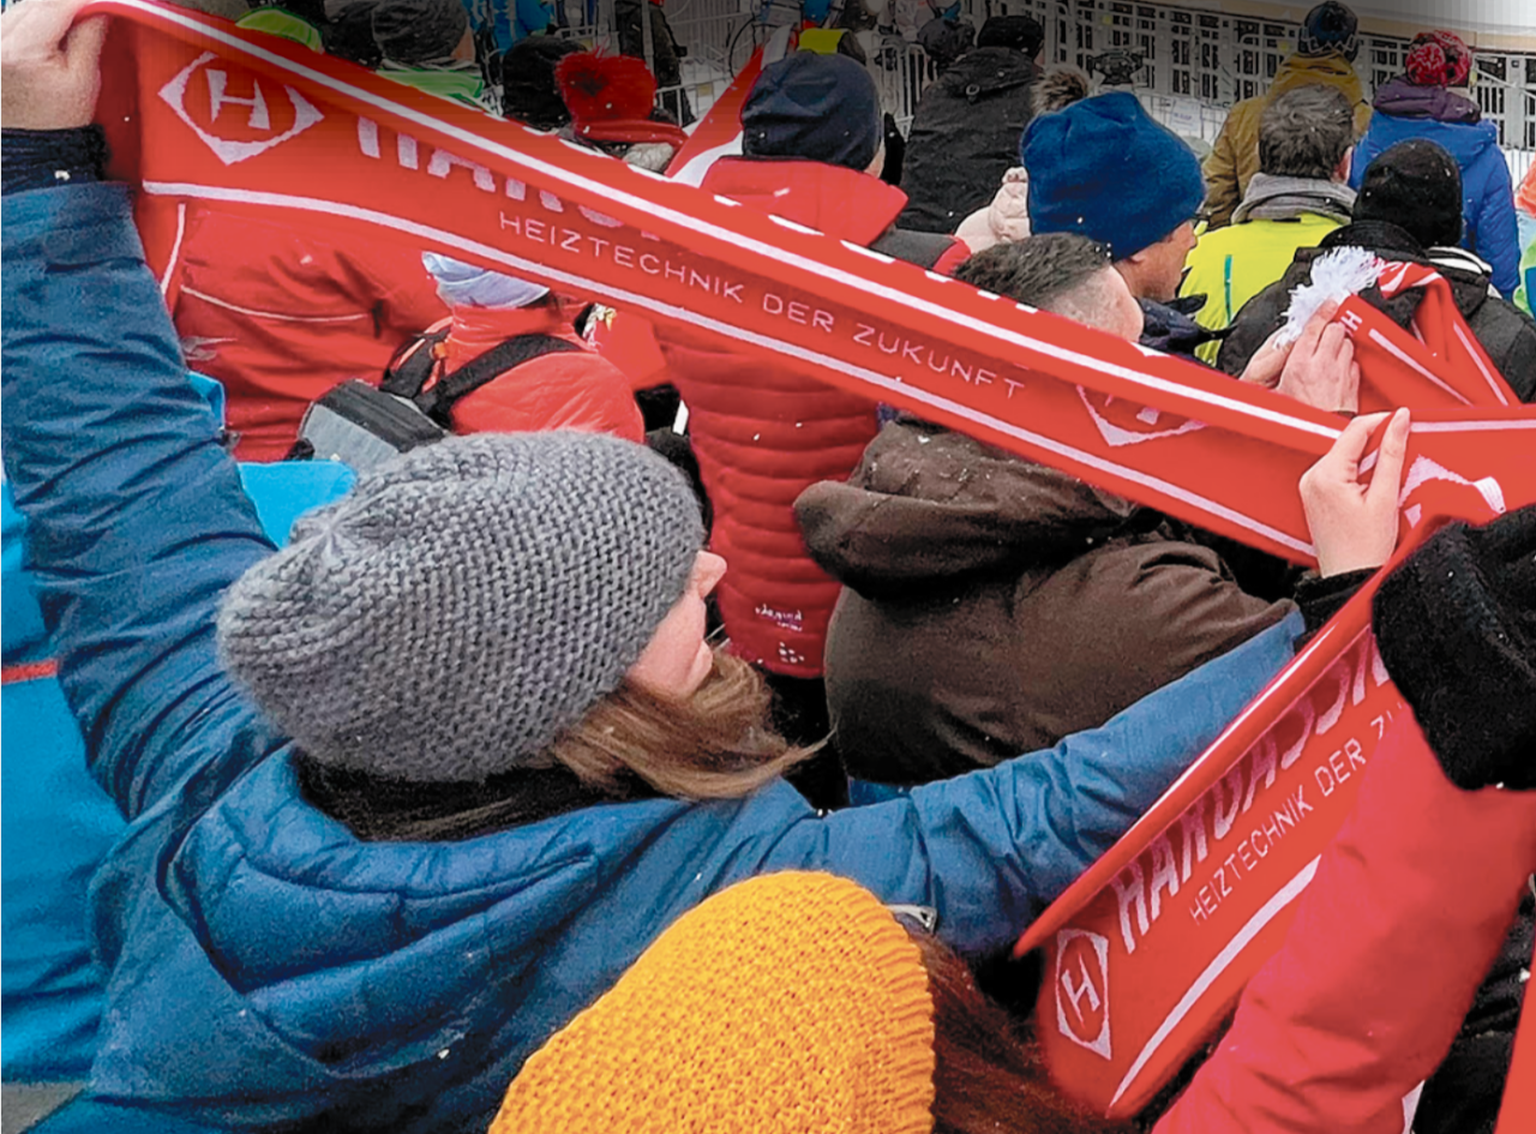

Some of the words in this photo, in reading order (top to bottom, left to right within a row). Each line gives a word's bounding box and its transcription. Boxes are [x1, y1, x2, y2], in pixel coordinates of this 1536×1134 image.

[500, 211, 744, 304] HEIZTECHNIK
[763, 291, 835, 334] DER
[852, 322, 1026, 399] ZUKUNFT
[1188, 791, 1313, 924] HEIZTECHNIK
[1316, 738, 1367, 797] DER
